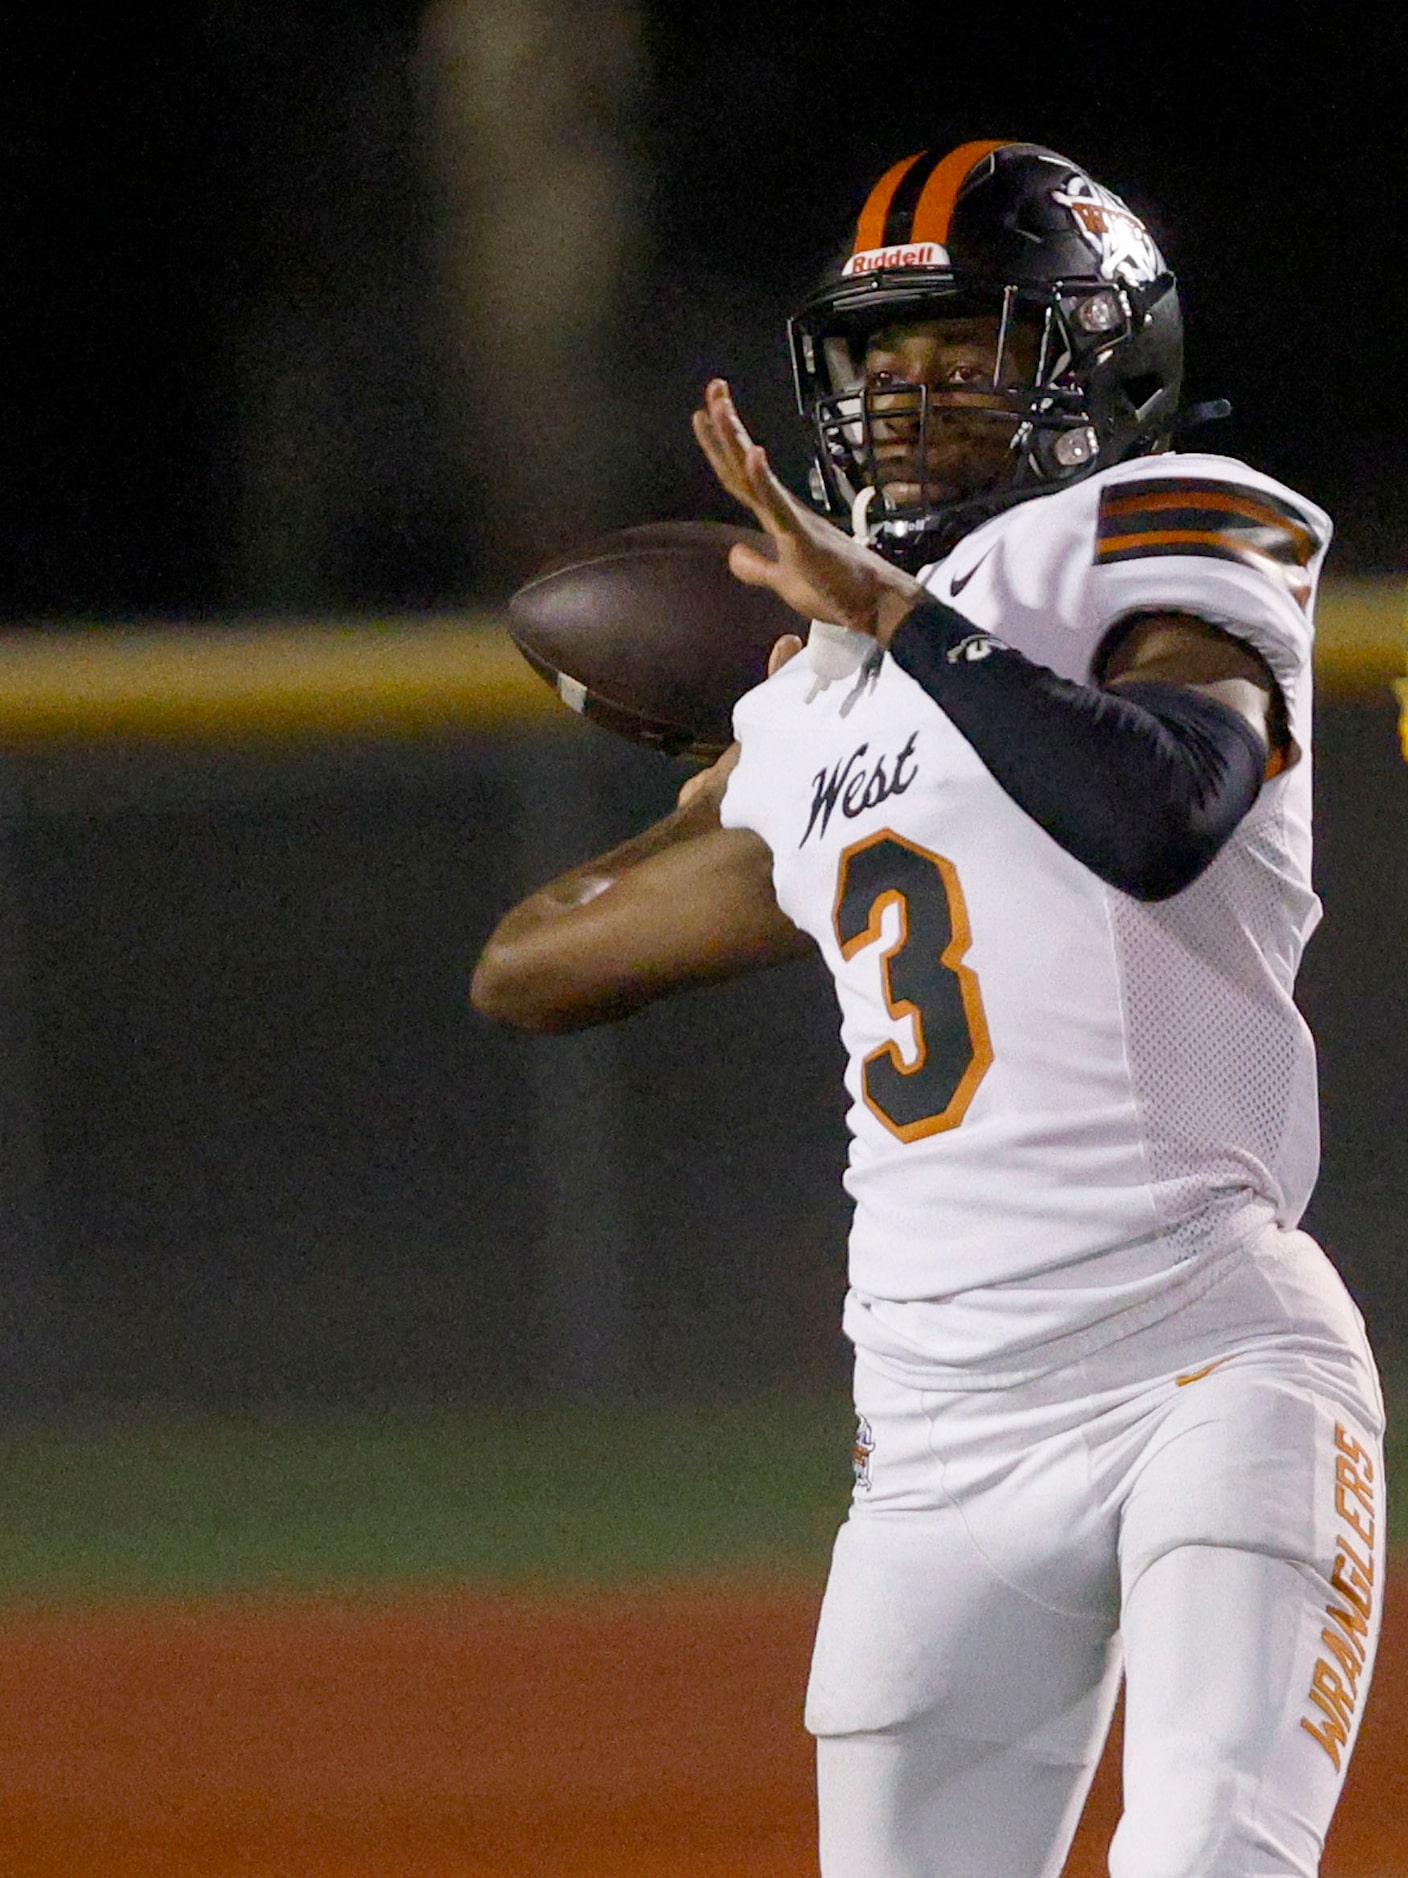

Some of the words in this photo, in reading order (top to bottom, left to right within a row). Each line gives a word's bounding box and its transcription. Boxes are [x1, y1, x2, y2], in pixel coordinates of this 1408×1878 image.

[852, 246, 934, 273] Riddell
[798, 730, 919, 849] West
[832, 827, 995, 1144] 3
[1301, 1420, 1375, 1773] WRANGLERS
